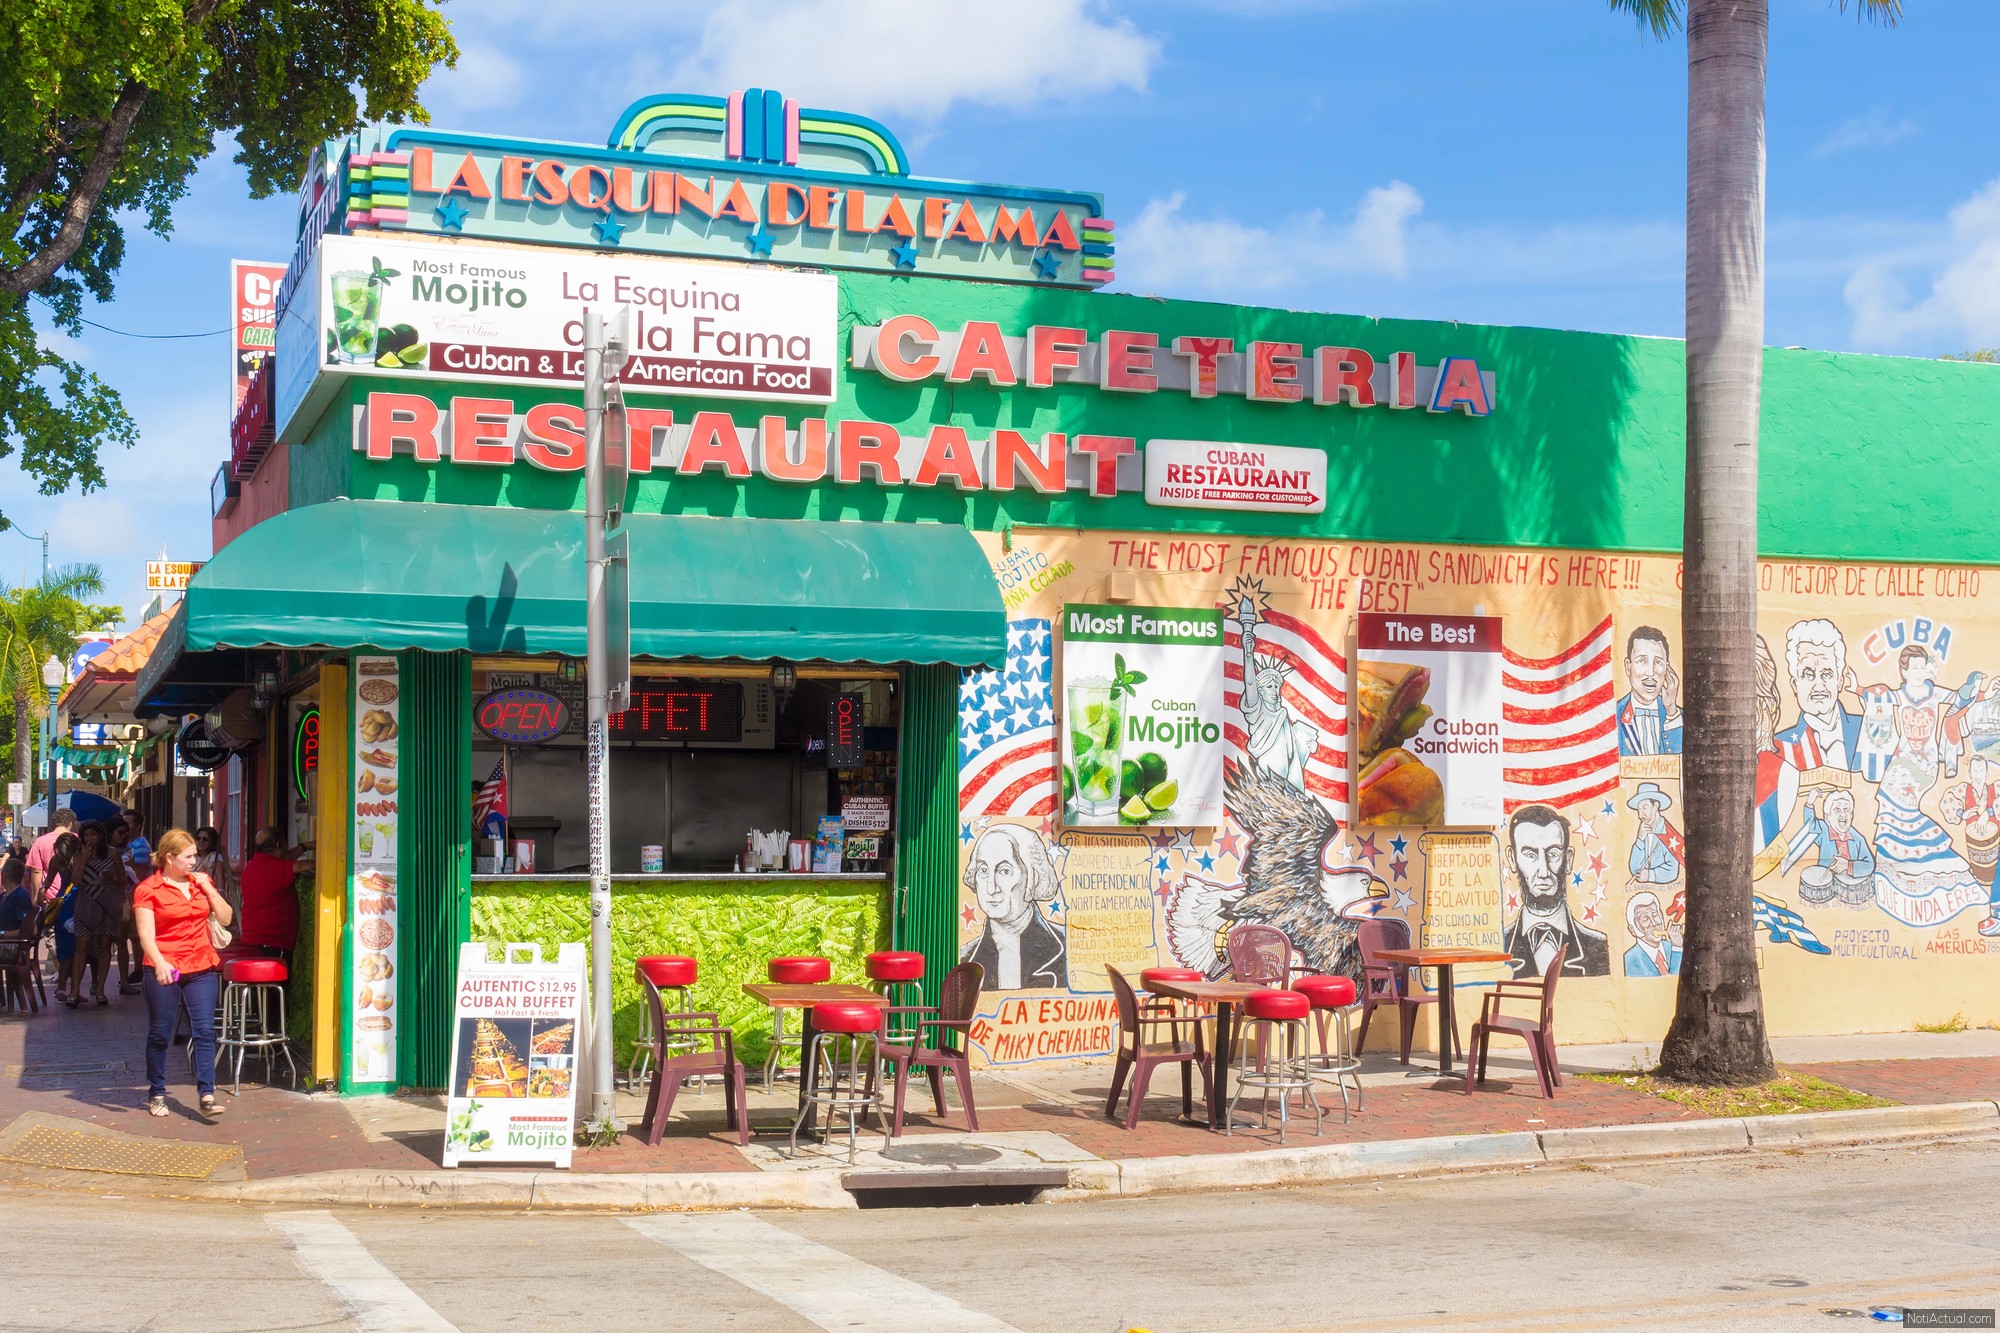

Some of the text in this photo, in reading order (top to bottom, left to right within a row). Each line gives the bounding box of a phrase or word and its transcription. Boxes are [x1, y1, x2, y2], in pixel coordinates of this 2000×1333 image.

[413, 147, 1081, 251] LA ESQUINA DE LA FAMA
[413, 260, 527, 280] Most Famous
[412, 275, 527, 311] Mojito
[562, 271, 740, 315] La Esquina
[637, 310, 673, 352] la
[693, 316, 811, 362] Fama
[443, 345, 530, 373] Cuban
[537, 355, 553, 374] &
[628, 356, 743, 385] American
[753, 364, 811, 390] Food
[870, 314, 1493, 419] CAFETERIA
[367, 391, 1136, 498] RESTAURANT
[1206, 450, 1265, 467] CUBAN
[1167, 463, 1311, 490] RESTAURANT
[1159, 487, 1200, 499] INSIDE
[1204, 490, 1313, 503] FREE PARKING FOR CUSTOMERS
[148, 563, 160, 574] LA
[1109, 541, 1160, 569] THE
[1167, 542, 1231, 574] MOST
[1239, 544, 1339, 578] FAMOUS
[1349, 545, 1420, 581] CUBAN
[1428, 550, 1529, 585] SANDWICH
[1540, 556, 1559, 586] IS
[149, 576, 176, 587] DE LA
[1029, 560, 1076, 593] COLADA
[1781, 565, 1838, 596] MEJOR
[1845, 567, 1867, 596] DE
[1874, 567, 1925, 597] CALLE
[1935, 569, 1980, 598] OCHO
[1070, 613, 1217, 638] Most Famous
[1385, 622, 1475, 643] The Best
[1863, 618, 1951, 664] CUBA
[1151, 699, 1196, 711] Cuban
[481, 703, 562, 729] OPEN
[1129, 716, 1220, 749] Mojito
[1433, 718, 1498, 736] Cuban
[1414, 737, 1498, 754] Sandwich
[1801, 771, 1850, 785] TITO PUENTE
[1071, 854, 1132, 869] PADRE DE LA
[1427, 852, 1492, 868] LIBERTADOR
[1071, 873, 1151, 891] INDEPENDENCIA
[1439, 872, 1482, 887] DE LA
[1070, 895, 1152, 912] NORTEAMERICANA
[1427, 890, 1499, 908] ESCLAVITUD
[1876, 879, 1980, 923] QUE LINDA ERES
[1446, 914, 1471, 927] COMO
[1473, 912, 1489, 926] NO
[1423, 931, 1500, 948] SERIA ESCLAVO
[1834, 929, 1890, 943] PROYECTO
[1936, 928, 1960, 940] LAS
[1833, 944, 1918, 960] MULTICULTURAL
[1925, 938, 1987, 955] AMERICAS
[461, 980, 577, 993] AUTENTIC $12.95
[460, 995, 576, 1008] CUBAN BUFFET
[1000, 1000, 1028, 1025] LA
[1039, 999, 1120, 1023] ESQUINA
[969, 1019, 1111, 1061] DE MIKY CHEVALIER
[532, 1123, 568, 1131] Famous
[507, 1131, 567, 1149] Mojito
